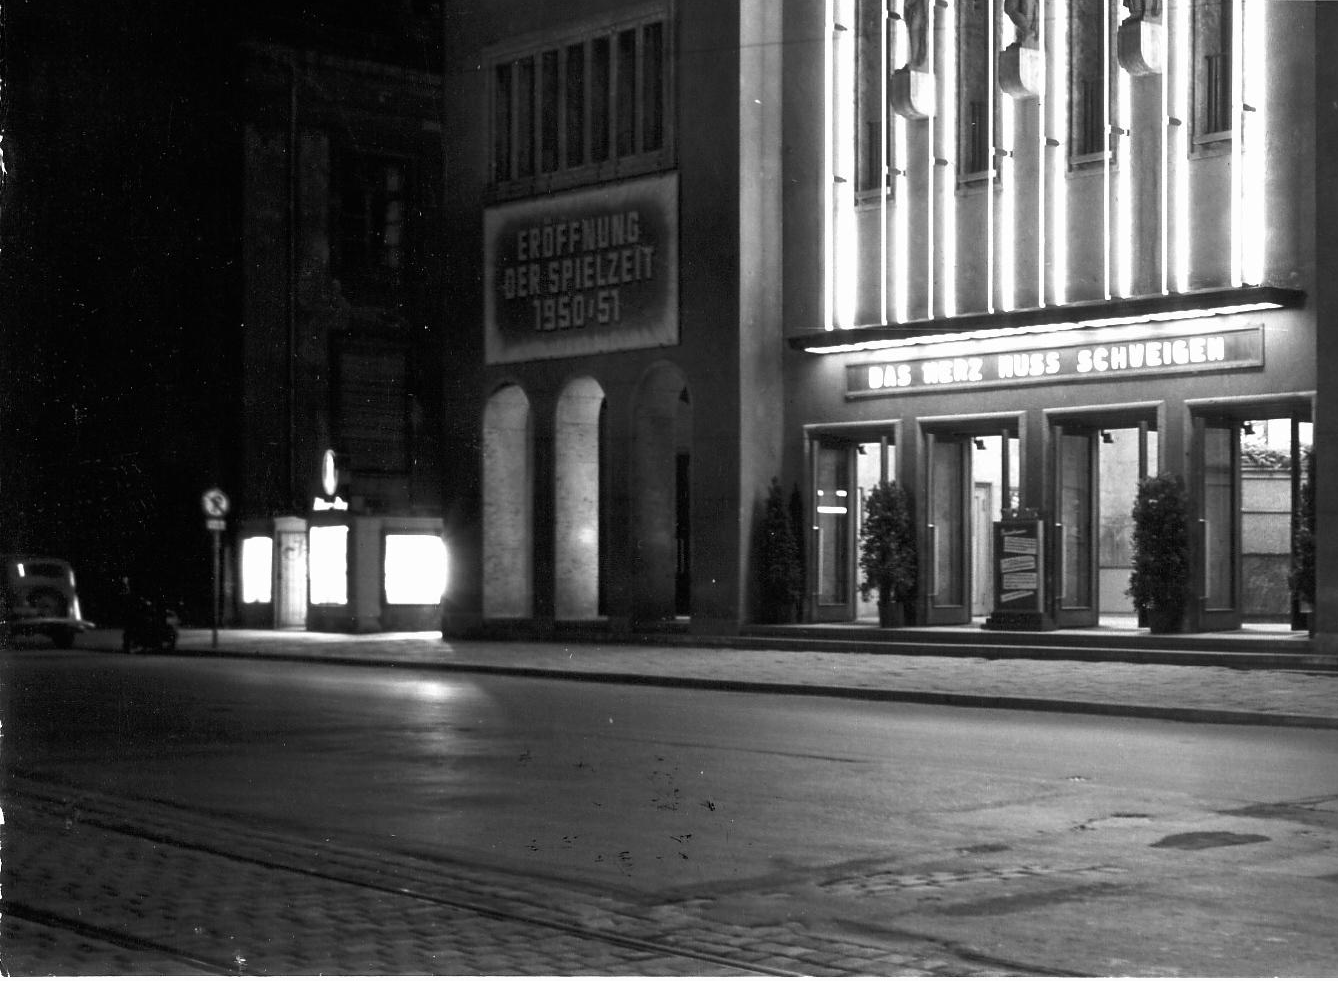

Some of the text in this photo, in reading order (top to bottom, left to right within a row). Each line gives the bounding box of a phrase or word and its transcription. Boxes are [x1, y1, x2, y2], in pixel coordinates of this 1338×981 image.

[517, 211, 640, 262] ERÖFFNUNG
[504, 245, 655, 299] DER SPIELZEIT
[868, 363, 912, 389] DAS
